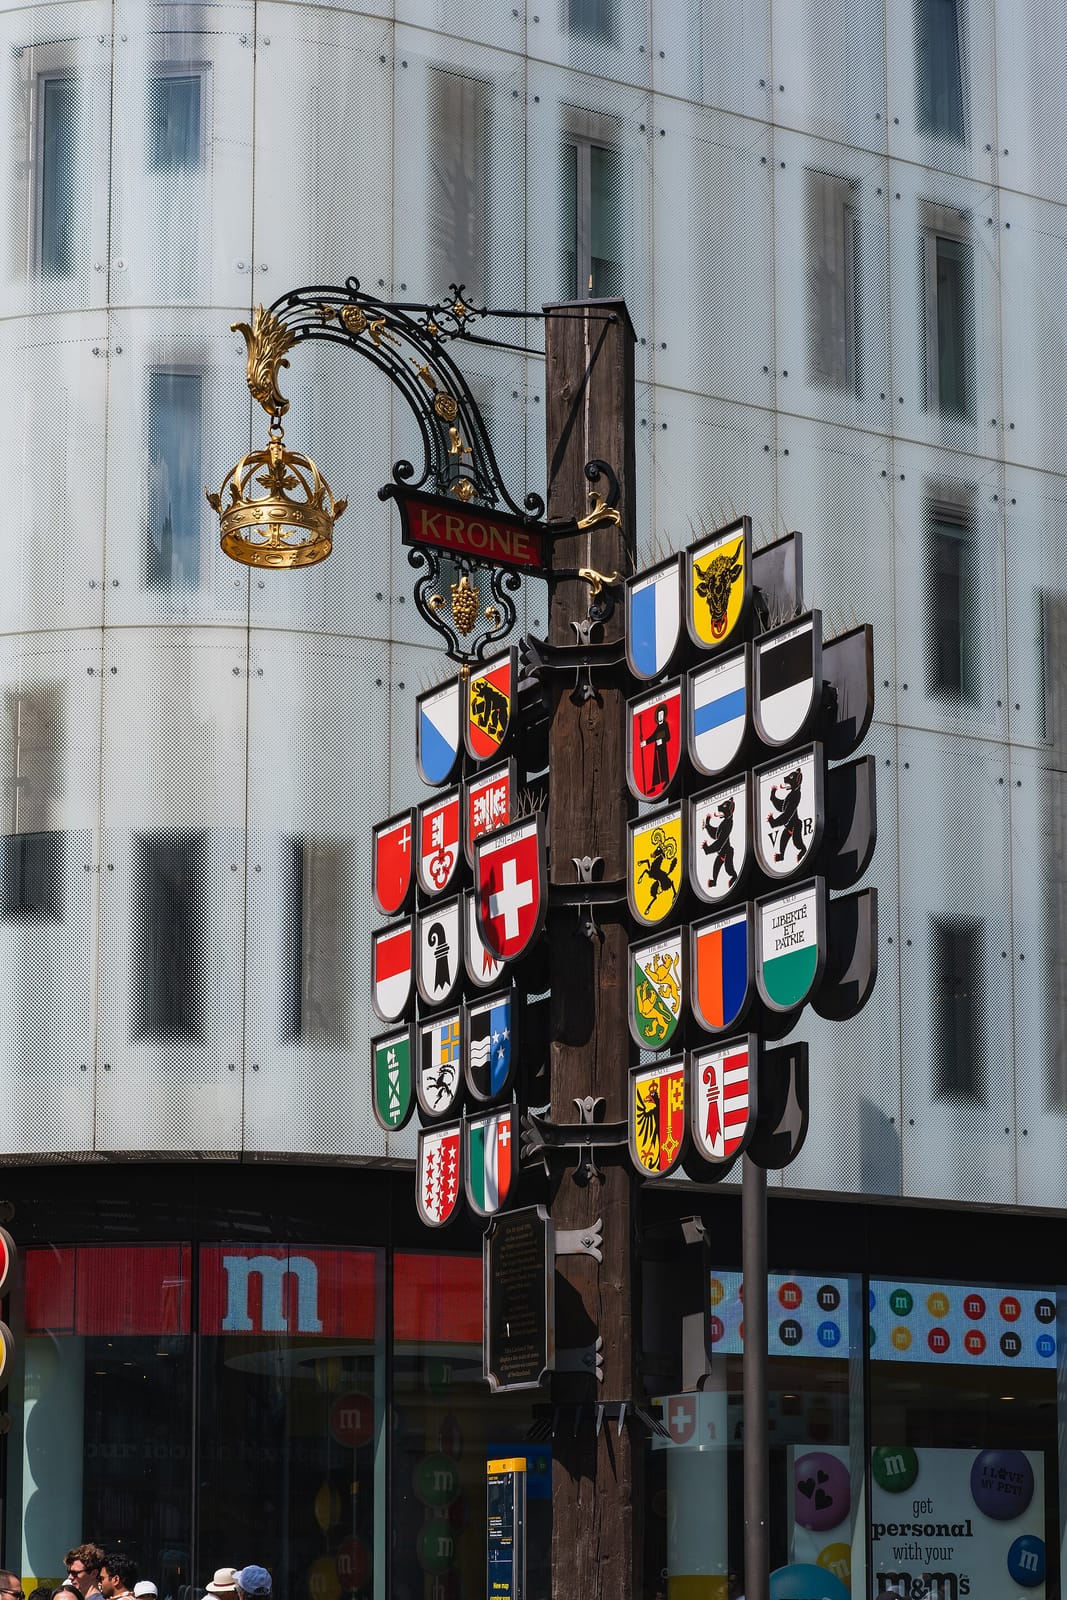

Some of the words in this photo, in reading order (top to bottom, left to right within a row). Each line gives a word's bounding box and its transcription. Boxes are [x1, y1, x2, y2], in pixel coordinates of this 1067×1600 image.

[420, 509, 531, 560] KRONE
[768, 830, 780, 848] V
[803, 817, 814, 836] R
[771, 904, 808, 929] LIBERTÉ
[783, 922, 796, 936] ET
[775, 930, 805, 951] PATRIE
[222, 1255, 323, 1332] m
[822, 1295, 835, 1304] m
[895, 1296, 908, 1309] m
[968, 1301, 981, 1313] m
[1004, 1304, 1016, 1315] m
[1040, 1306, 1052, 1317] m
[784, 1327, 797, 1339] m
[933, 1335, 945, 1347] m
[969, 1337, 981, 1348] m
[1005, 1339, 1017, 1350] m
[339, 1408, 362, 1429] m
[883, 1454, 906, 1476] m
[433, 1470, 454, 1491] m
[912, 1497, 934, 1519] get
[871, 1519, 974, 1541] personal
[892, 1541, 922, 1561] with
[924, 1546, 954, 1566] your
[1018, 1549, 1039, 1572] m
